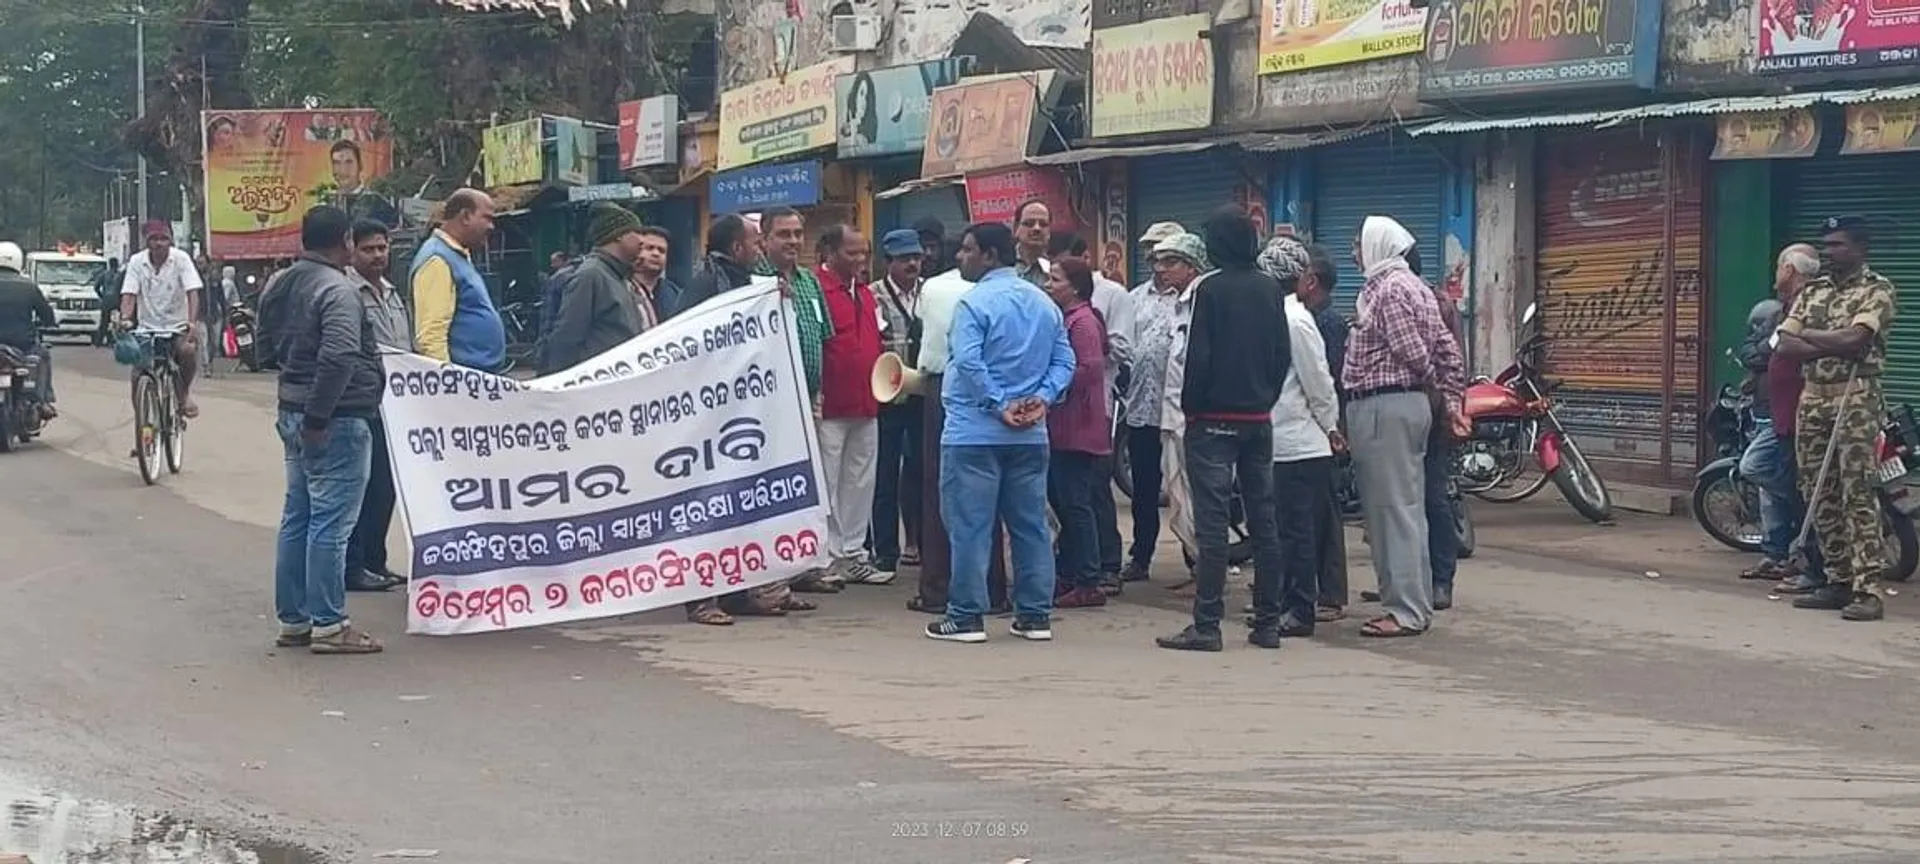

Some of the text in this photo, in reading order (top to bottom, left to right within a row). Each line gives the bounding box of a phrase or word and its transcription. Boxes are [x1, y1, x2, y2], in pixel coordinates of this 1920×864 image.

[1361, 33, 1422, 54] MALLICK STORE
[1758, 53, 1857, 70] ANJALI MIXTURES
[703, 311, 765, 352] ଖୋଲିବା
[575, 409, 623, 439] କଟକ
[629, 391, 697, 436] ସ୍ଥାନାନ୍ତର
[700, 382, 729, 410] ବନ୍ଦ
[445, 416, 767, 512] ଆମର ଦାବି
[556, 522, 603, 553] ଜିଲ୍ଲା
[670, 493, 734, 533] ସୁରକ୍ଷା
[739, 474, 808, 511] ଅଭିଯାନ
[544, 581, 568, 610] ୭
[580, 541, 768, 605] ଜଗତସିଂହପୁର
[774, 529, 820, 560] ବନ୍ଦ
